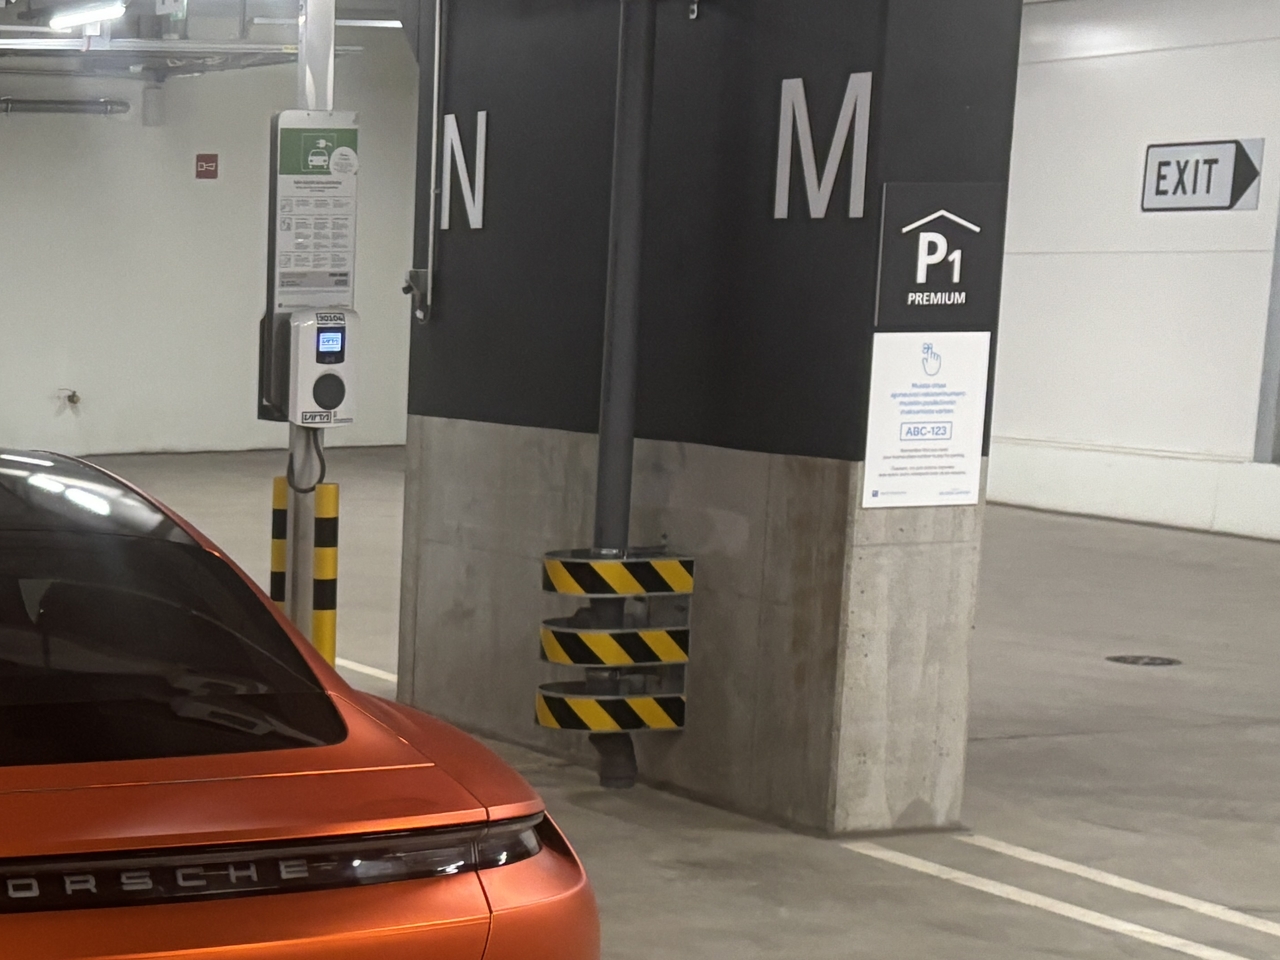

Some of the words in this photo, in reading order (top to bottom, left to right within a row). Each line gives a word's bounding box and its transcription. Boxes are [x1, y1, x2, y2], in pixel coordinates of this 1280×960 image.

[774, 71, 873, 219] M
[440, 110, 487, 229] N
[1155, 158, 1219, 196] EXIT
[907, 291, 966, 305] PREMIUM
[905, 426, 947, 437] ABC-123
